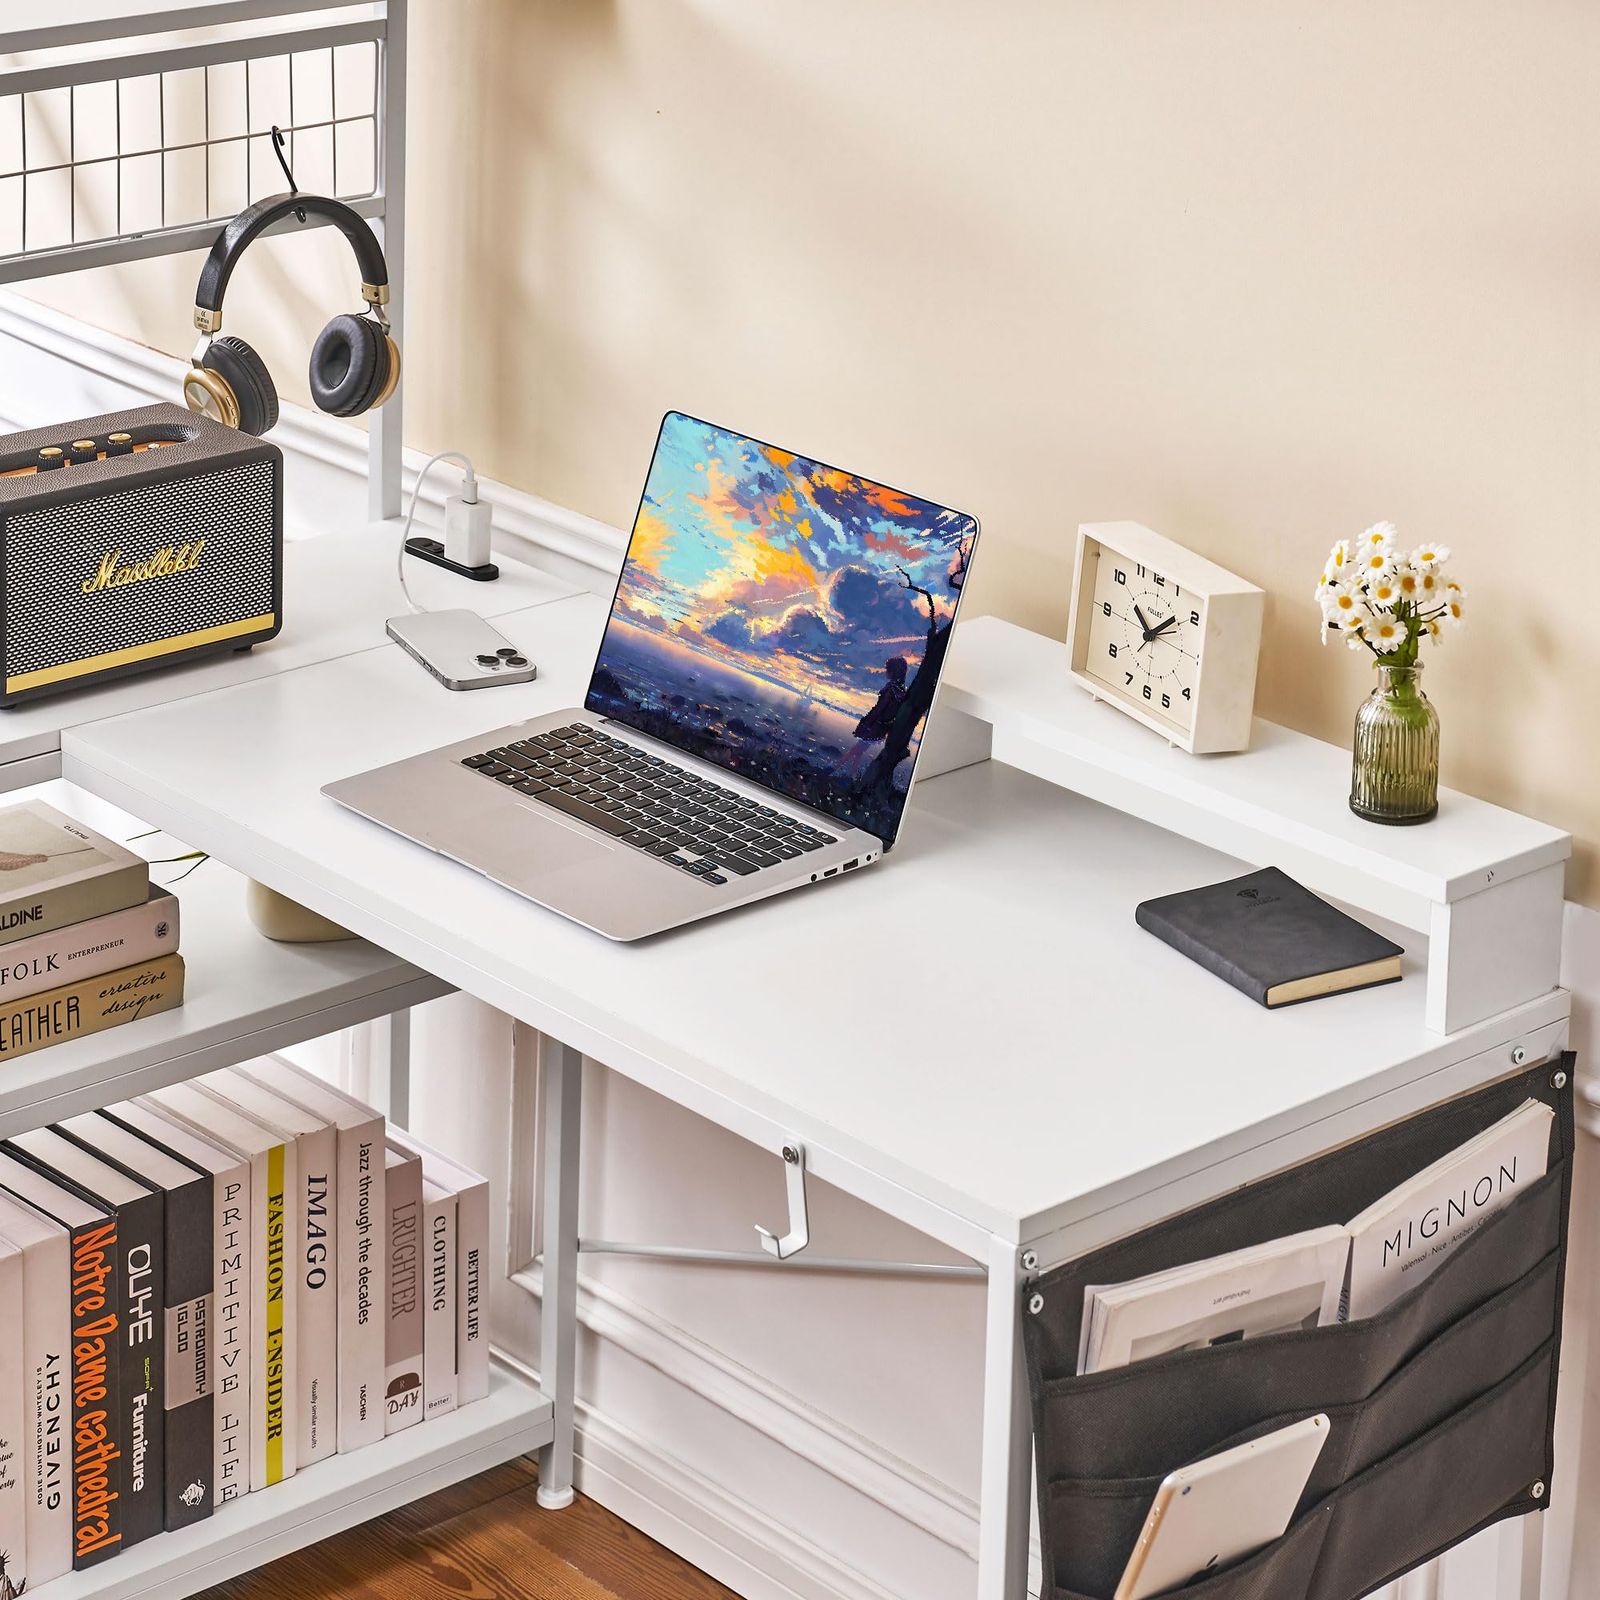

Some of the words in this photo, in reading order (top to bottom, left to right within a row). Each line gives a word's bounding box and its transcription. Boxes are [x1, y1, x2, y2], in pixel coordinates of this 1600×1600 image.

[1114, 569, 1127, 586] 10
[1153, 572, 1165, 587] 12
[1103, 601, 1112, 618] 9
[1190, 610, 1200, 627] 2
[1108, 643, 1118, 659] 8
[1125, 671, 1134, 686] 7
[1143, 685, 1153, 700] 6
[1182, 688, 1191, 702] 4
[1162, 694, 1171, 709] 5
[0, 952, 60, 986] FOLK
[67, 938, 125, 961] ENTERPRENEUR
[98, 970, 167, 999] creative
[101, 991, 164, 1022] design
[359, 1142, 372, 1174] Jazz
[356, 1174, 372, 1236] through
[1382, 1156, 1518, 1268] MIGNON
[268, 1192, 284, 1303] FASHION
[306, 1173, 328, 1290] IMAGO
[358, 1237, 372, 1263] the
[391, 1201, 417, 1321] LRUGHTER
[433, 1215, 447, 1313] CLOTHING
[1432, 1242, 1447, 1255] Nice
[73, 1221, 118, 1317] Notre
[467, 1248, 480, 1307] BETTER
[220, 1182, 242, 1395] PRIMITIVE
[358, 1265, 372, 1326] decades
[177, 1304, 189, 1354] IGLOO
[467, 1307, 479, 1342] LIFE
[73, 1312, 120, 1408] Dame
[194, 1298, 206, 1396] ASTRONOMY
[36, 1365, 43, 1375] IS
[311, 1377, 319, 1405] Visually
[359, 1383, 367, 1422] TASCHEN
[386, 1389, 419, 1416] DAY
[427, 1396, 450, 1409] Better
[311, 1403, 319, 1426] similar
[46, 1353, 61, 1511] GIVENCHY
[132, 1393, 149, 1493] Furniture
[310, 1426, 318, 1450] results
[220, 1413, 240, 1504] LIFE
[74, 1410, 122, 1558] cathedral
